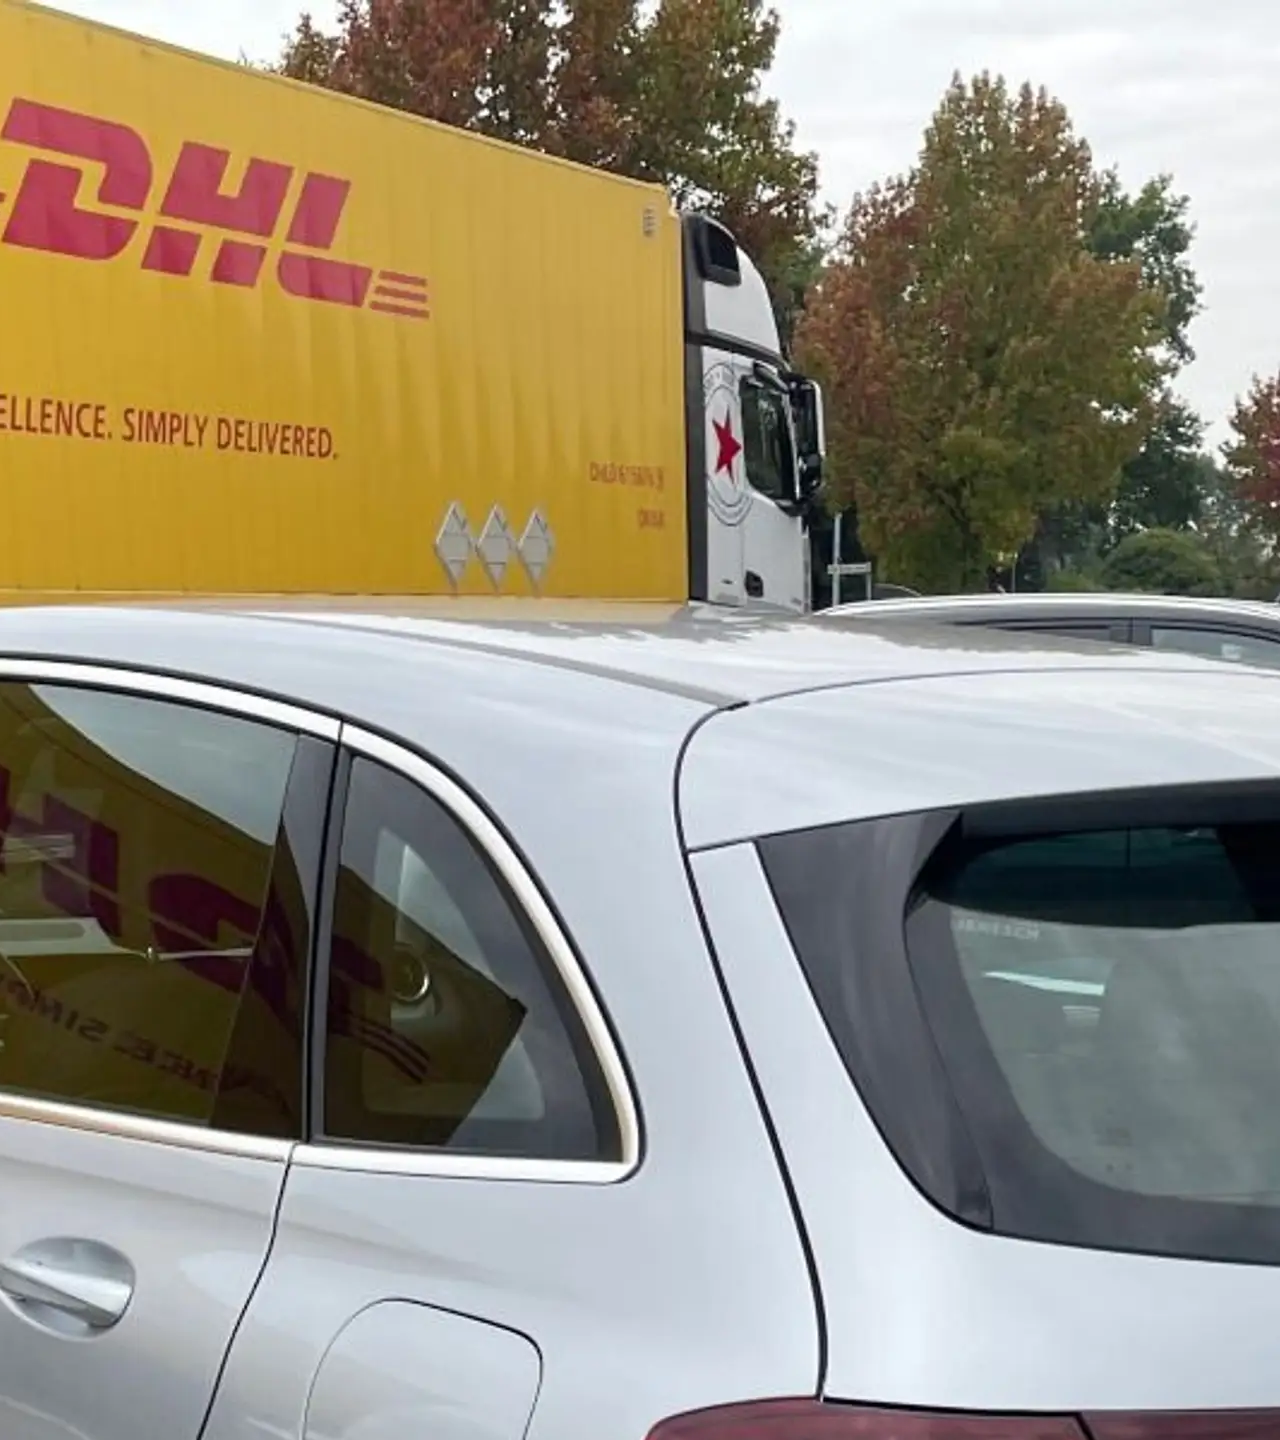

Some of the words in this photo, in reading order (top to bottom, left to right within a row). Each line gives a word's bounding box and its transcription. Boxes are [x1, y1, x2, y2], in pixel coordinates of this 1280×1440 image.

[0, 97, 373, 308] DHL
[122, 407, 208, 448] SIMPLY
[216, 417, 339, 461] DELIVERED.
